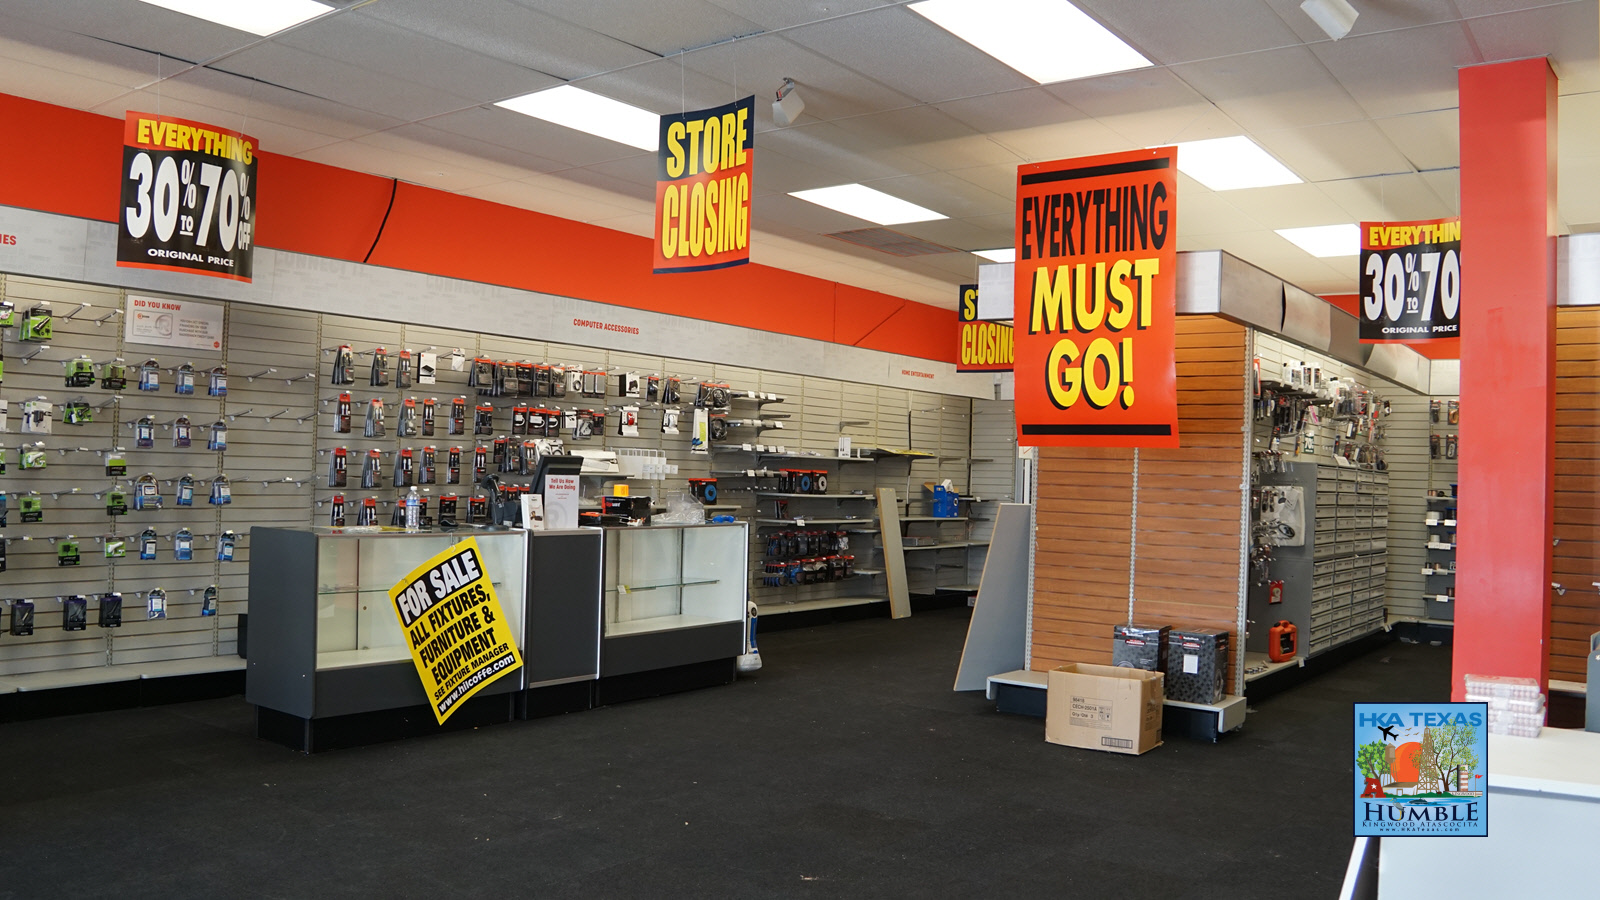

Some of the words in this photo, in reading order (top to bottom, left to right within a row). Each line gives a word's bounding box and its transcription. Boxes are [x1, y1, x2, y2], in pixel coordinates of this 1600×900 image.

[137, 118, 253, 165] EVERYTHING
[666, 107, 748, 178] STORE
[180, 215, 194, 235] TO
[238, 221, 251, 250] OFF
[662, 172, 748, 259] CLOSING
[1021, 181, 1168, 260] EVERYTHING
[1369, 221, 1461, 246] EVERYTHIN
[147, 248, 204, 263] ORIGINAL
[207, 256, 234, 267] PRICE
[134, 299, 146, 307] DID
[148, 301, 160, 309] YOU
[162, 303, 182, 311] KNOW
[1028, 258, 1160, 335] MUST
[1406, 296, 1419, 313] TO
[573, 318, 603, 330] COMPUTER
[604, 323, 640, 335] ACCESSORIES
[1382, 326, 1429, 334] ORIGINAL
[1432, 324, 1458, 333] PRICE
[1045, 337, 1135, 410] GO!
[397, 579, 433, 625] FOR
[429, 551, 481, 599] SALE
[410, 621, 431, 650] ALL
[427, 584, 491, 632] FIXTURES,
[419, 613, 482, 669] FURNITURE
[483, 605, 496, 624] &
[431, 627, 497, 687] EQUIPMENT
[434, 687, 446, 701] SEE
[445, 665, 471, 692] FIXTURE
[471, 642, 510, 671] MANAGER
[438, 654, 515, 713] www.hilcoffe.com
